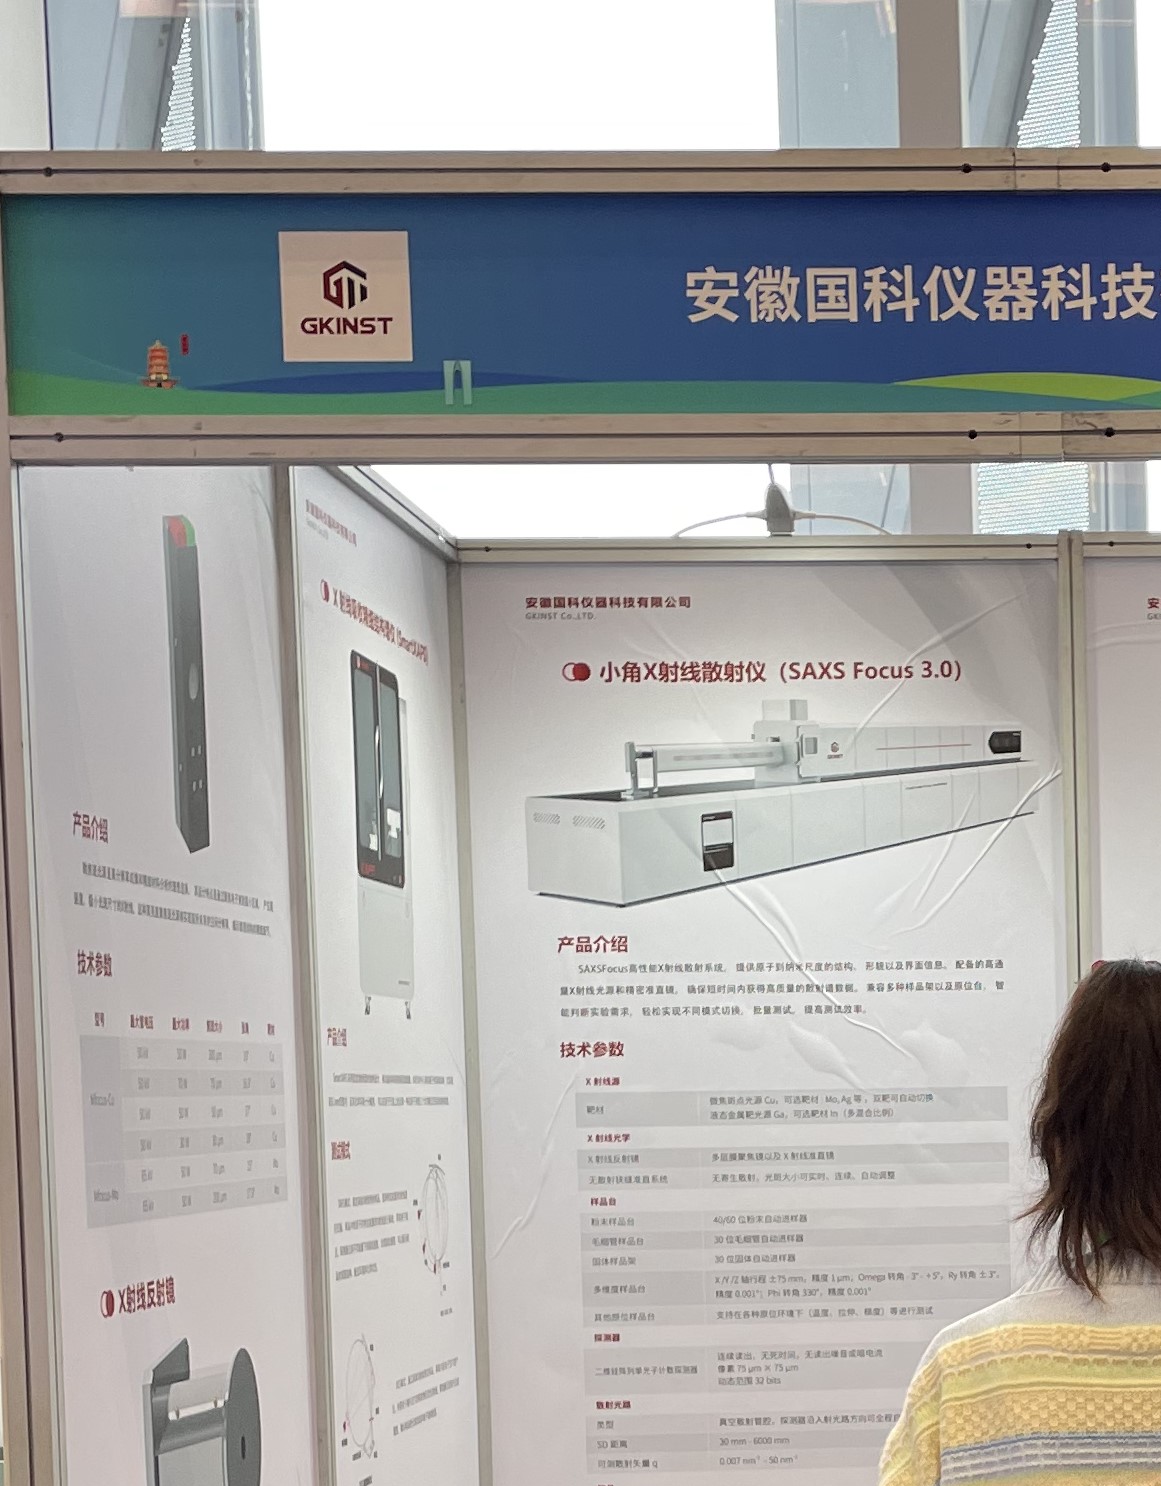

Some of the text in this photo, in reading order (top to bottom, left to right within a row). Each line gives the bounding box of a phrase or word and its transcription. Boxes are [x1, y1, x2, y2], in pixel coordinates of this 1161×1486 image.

[300, 317, 393, 335] GKINST
[525, 595, 693, 609] 安徽国科仪器科技有限公司
[852, 661, 915, 681] Focus
[72, 811, 109, 844] 产品介绍
[557, 935, 629, 954] 产品介绍
[77, 949, 114, 977] 技术参数
[560, 1040, 626, 1059] 技术参数
[590, 1196, 617, 1207] 样品台
[118, 1275, 176, 1314] X射线反射镜
